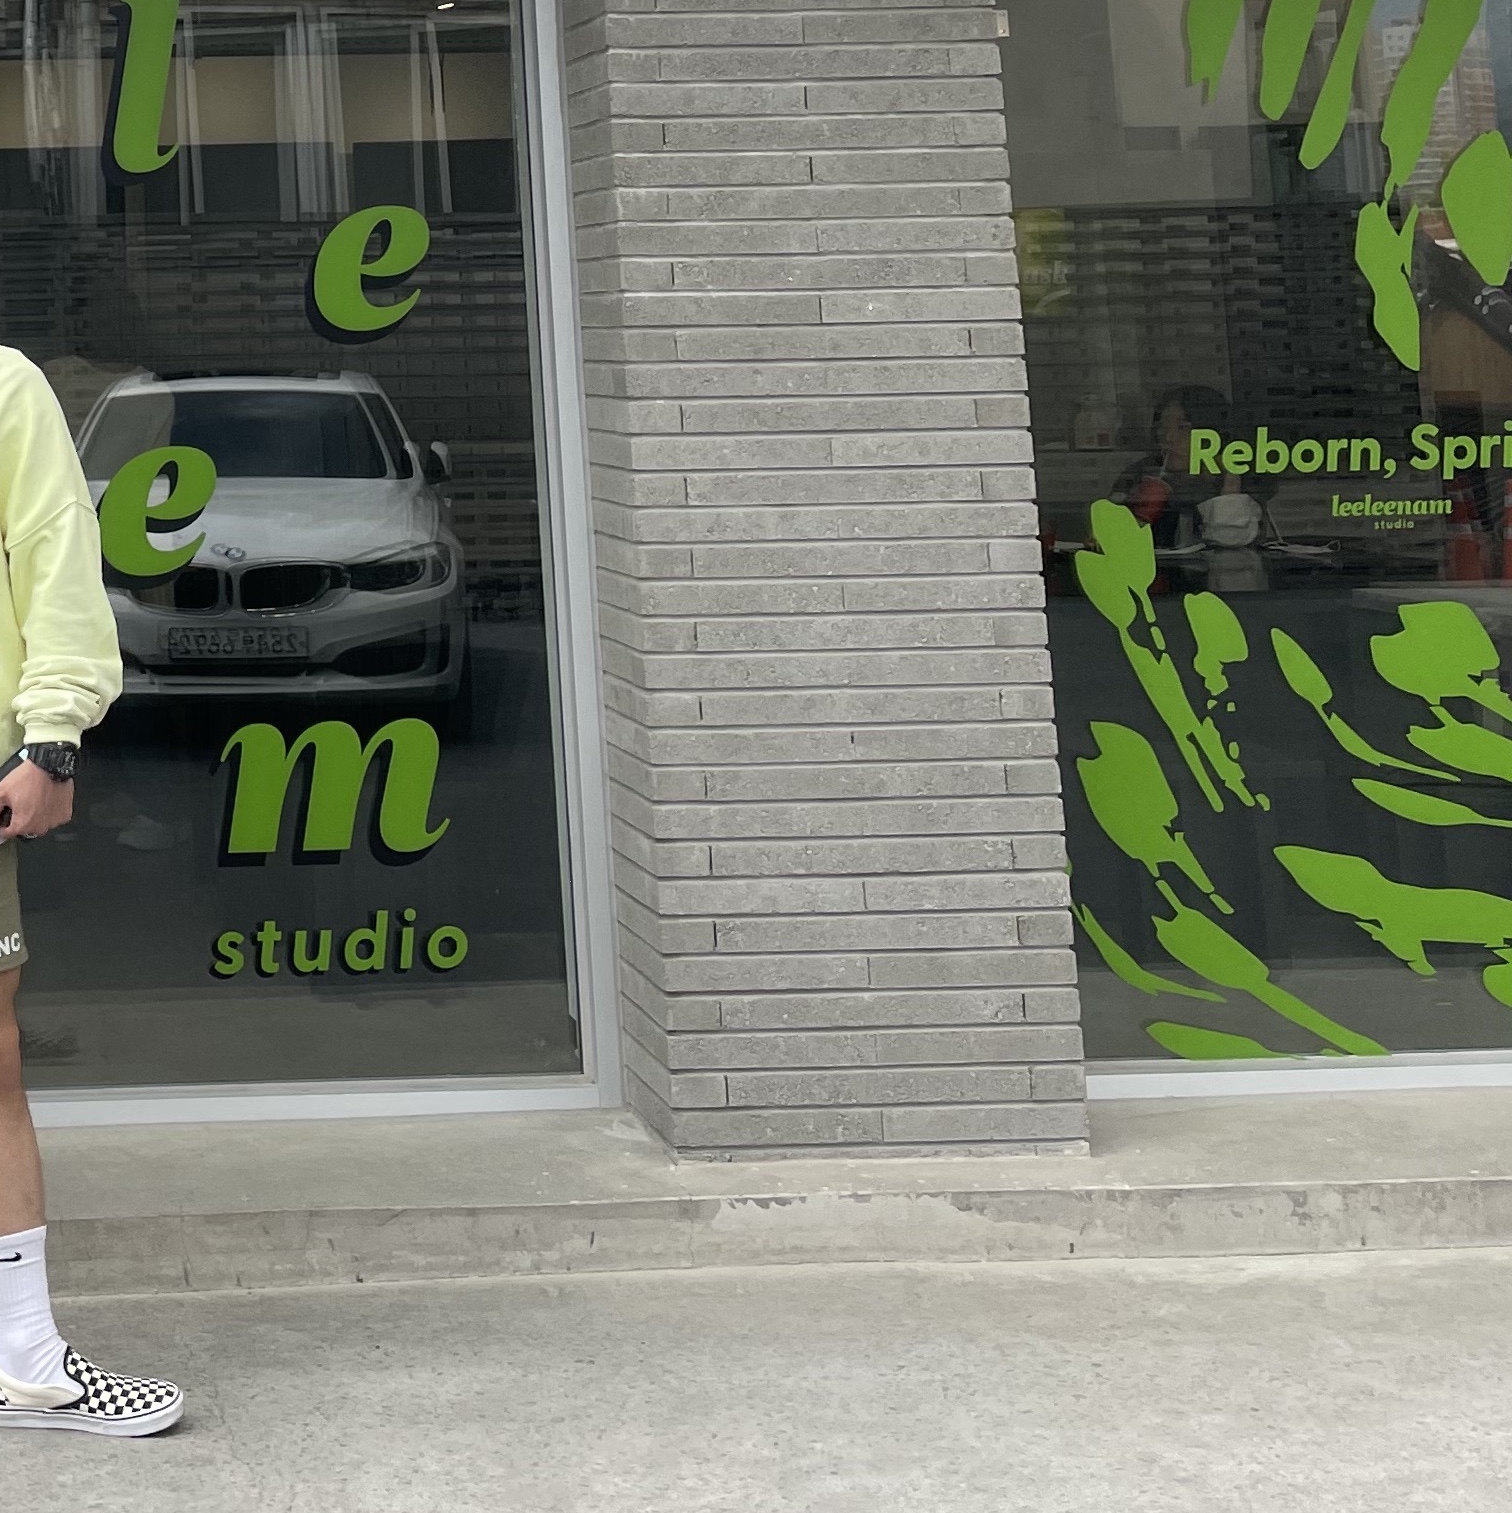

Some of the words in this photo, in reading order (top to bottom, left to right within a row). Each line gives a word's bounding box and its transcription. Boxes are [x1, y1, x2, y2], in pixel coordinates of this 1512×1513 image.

[314, 205, 430, 332] e
[1188, 426, 1397, 478] Reborn,
[98, 445, 217, 577] e
[1332, 493, 1454, 517] leeleenam
[1374, 519, 1415, 530] studio
[221, 718, 450, 853] m
[214, 907, 469, 975] studio
